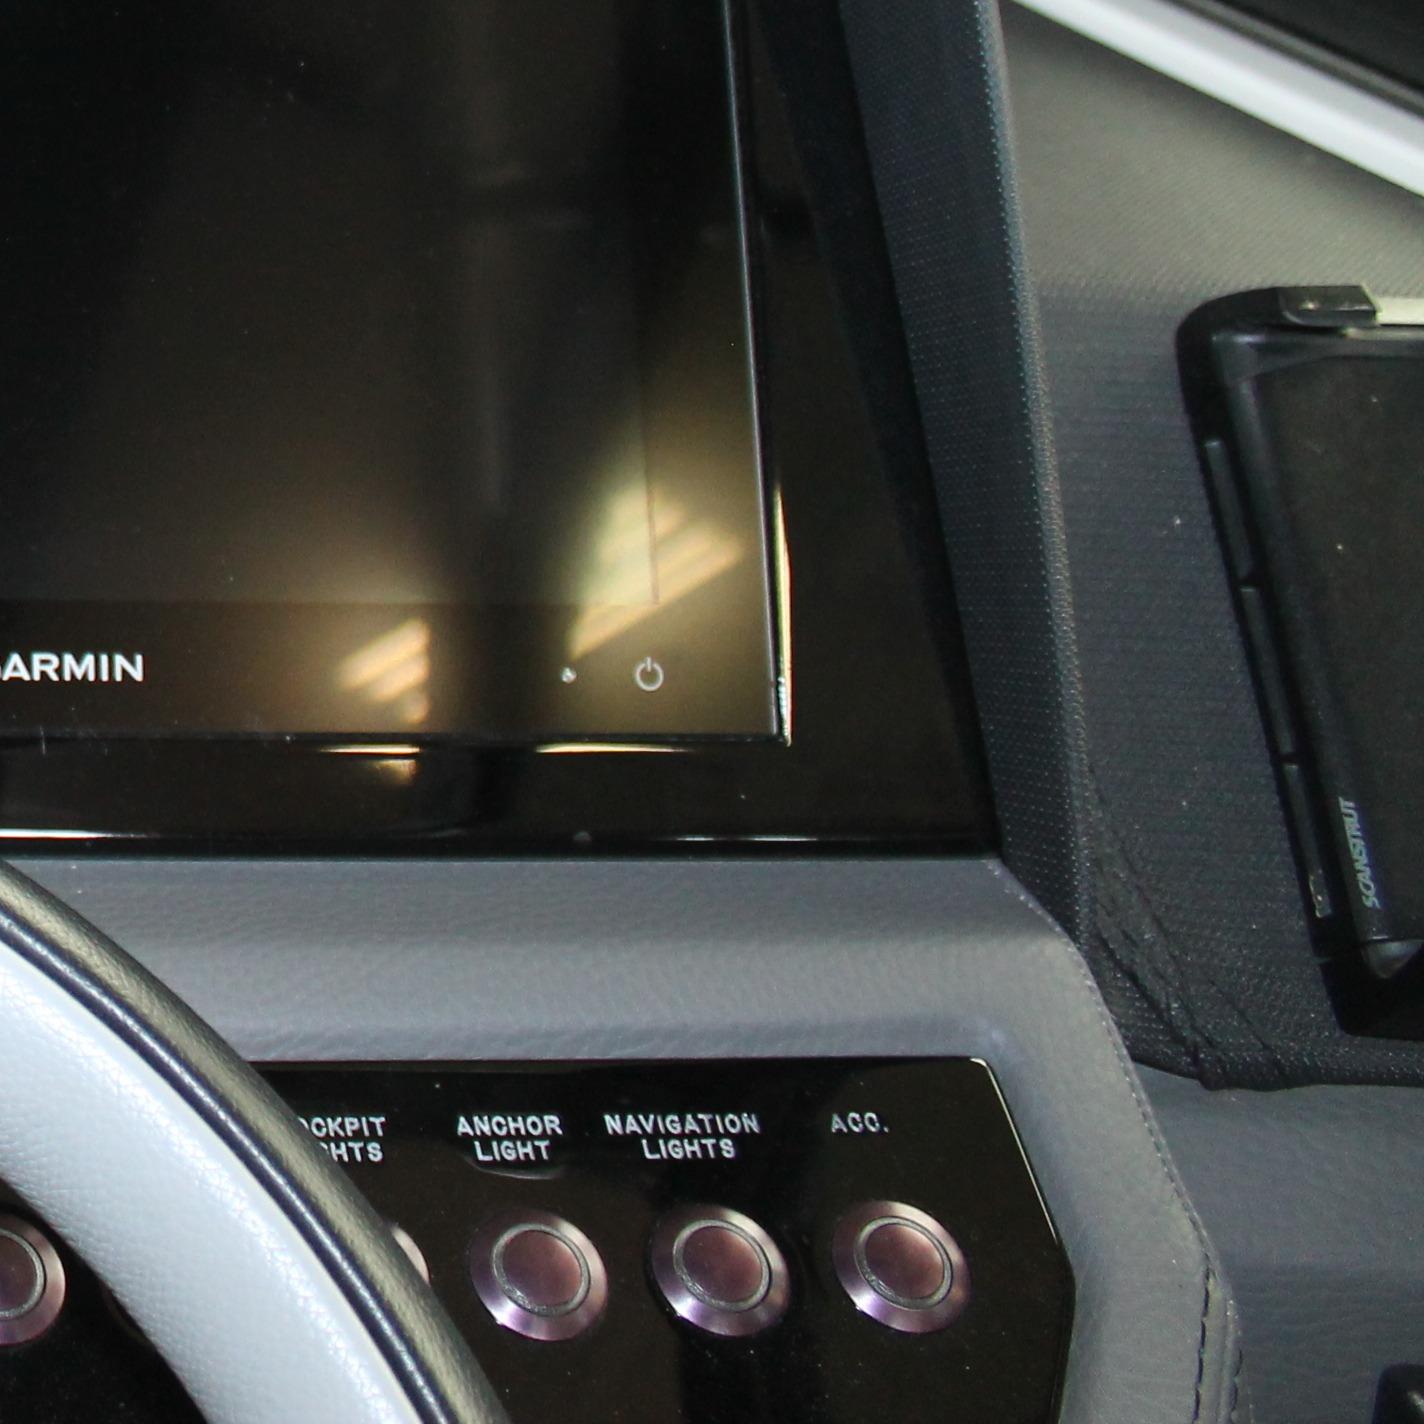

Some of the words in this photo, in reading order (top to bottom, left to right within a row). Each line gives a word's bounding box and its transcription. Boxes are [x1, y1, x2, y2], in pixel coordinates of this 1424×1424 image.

[1337, 796, 1381, 909] SCANSTRUT
[297, 1116, 387, 1138] CKPIT
[456, 1114, 563, 1137] ANCHOR
[603, 1112, 760, 1135] NAVIGATION
[830, 1111, 890, 1134] ACC.
[473, 1139, 551, 1162] LIGHT
[641, 1138, 736, 1160] LIGHTS
